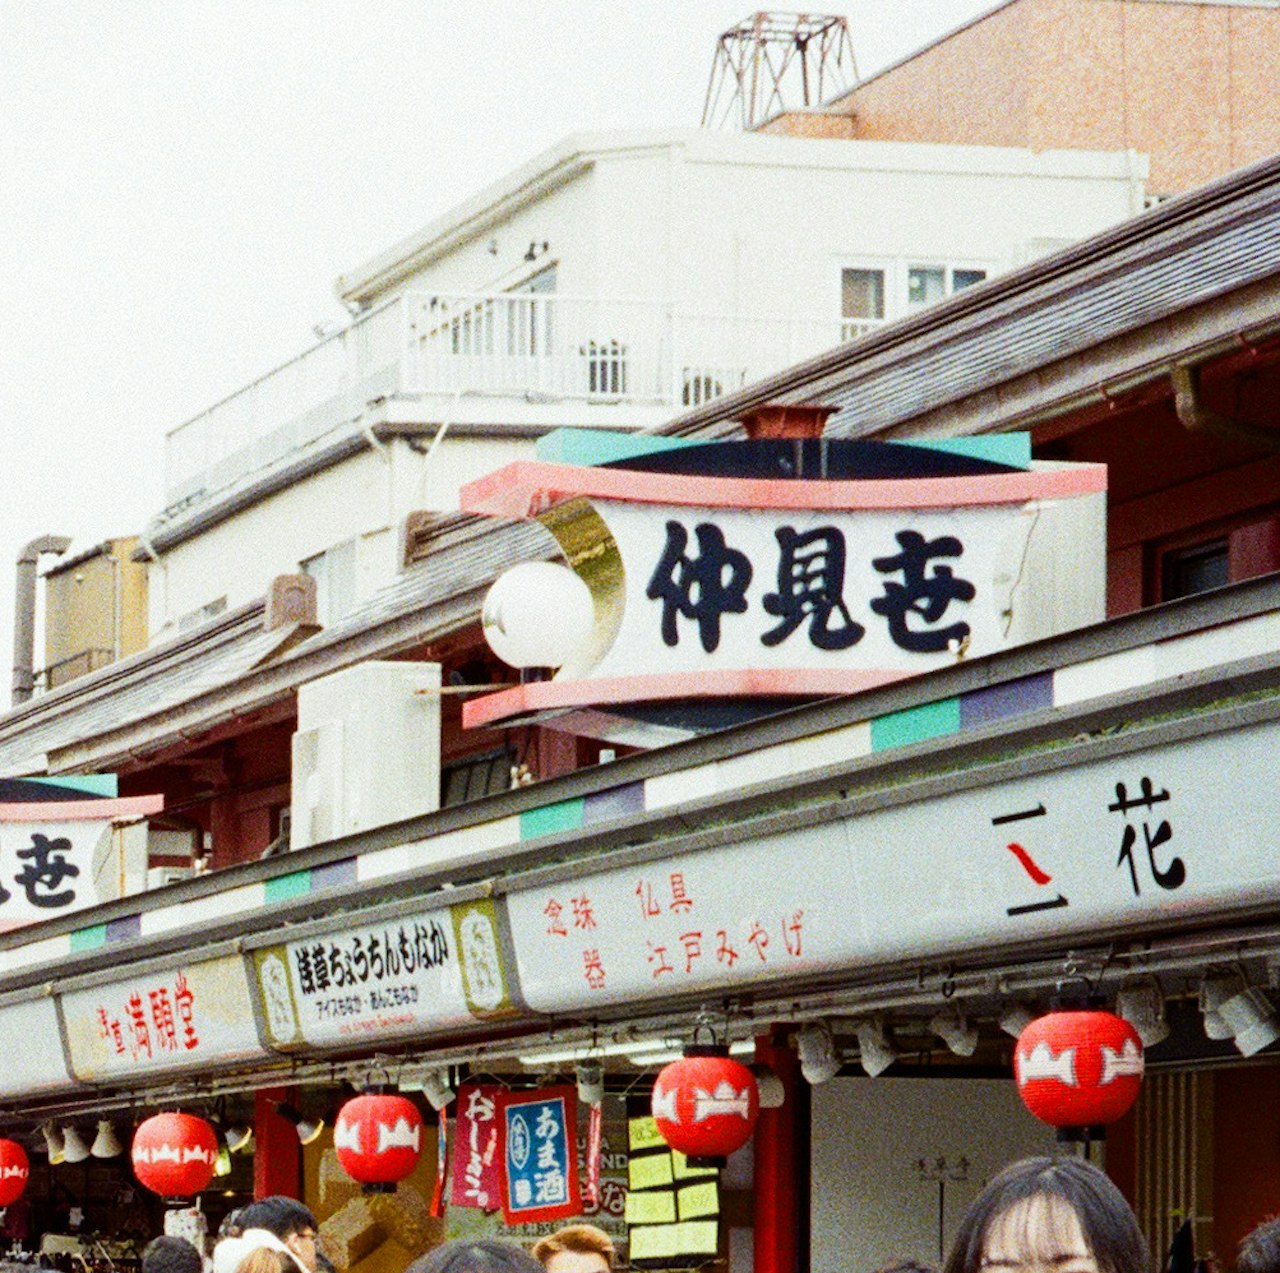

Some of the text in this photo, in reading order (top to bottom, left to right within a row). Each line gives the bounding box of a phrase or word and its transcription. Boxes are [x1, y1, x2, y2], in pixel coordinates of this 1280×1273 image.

[644, 519, 977, 653] 仲見世
[647, 909, 804, 979] 江戸みやげ
[535, 1106, 565, 1203] あま酒
